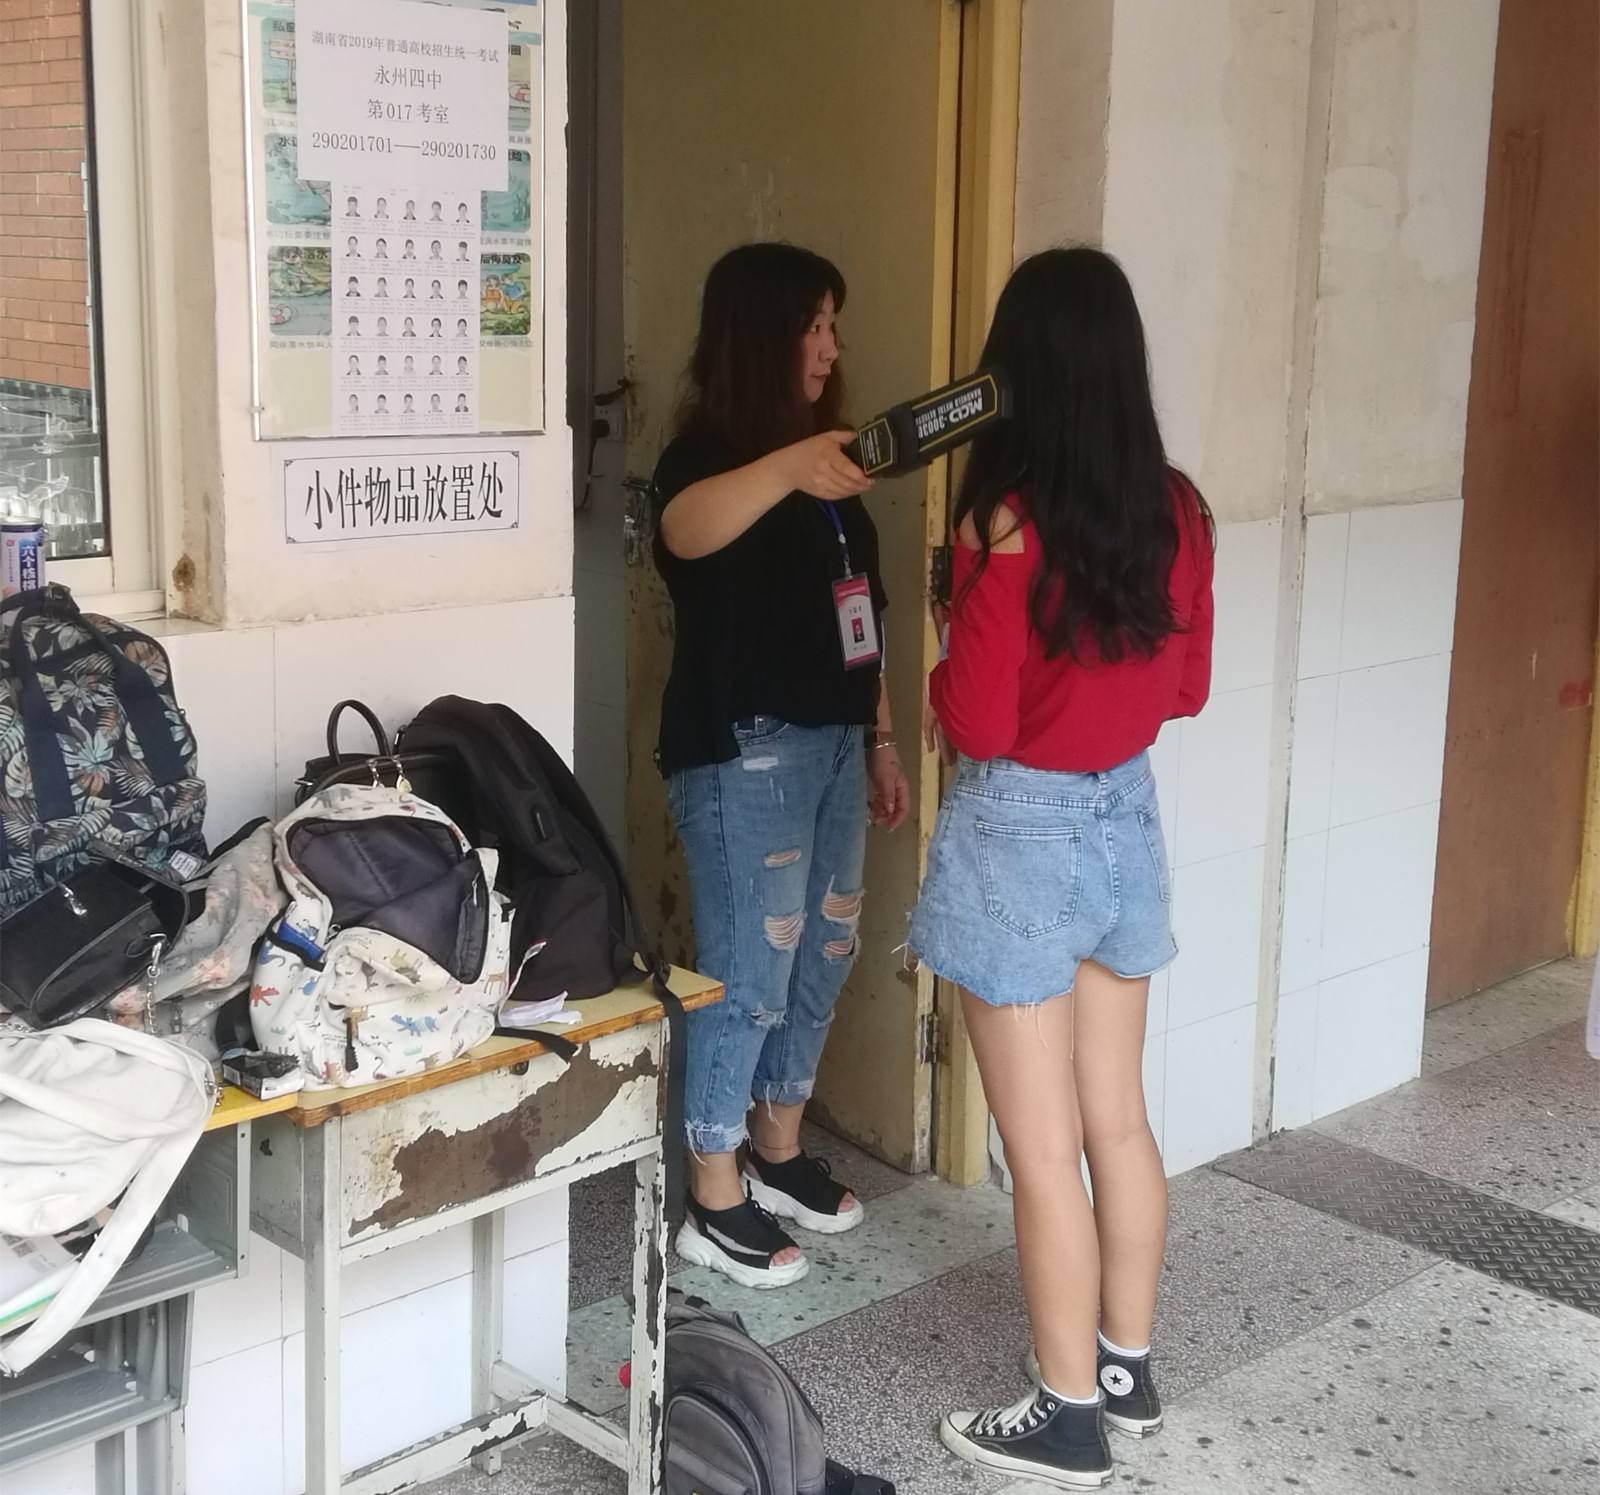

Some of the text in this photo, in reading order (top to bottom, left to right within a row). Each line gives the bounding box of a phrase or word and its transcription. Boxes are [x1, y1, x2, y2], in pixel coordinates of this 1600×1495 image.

[311, 30, 499, 63] 湖南省2019年普通高校招生统一考试
[374, 65, 442, 90] 永州四中
[368, 99, 450, 125] 第017考室
[304, 461, 504, 531] 小件物品放置处
